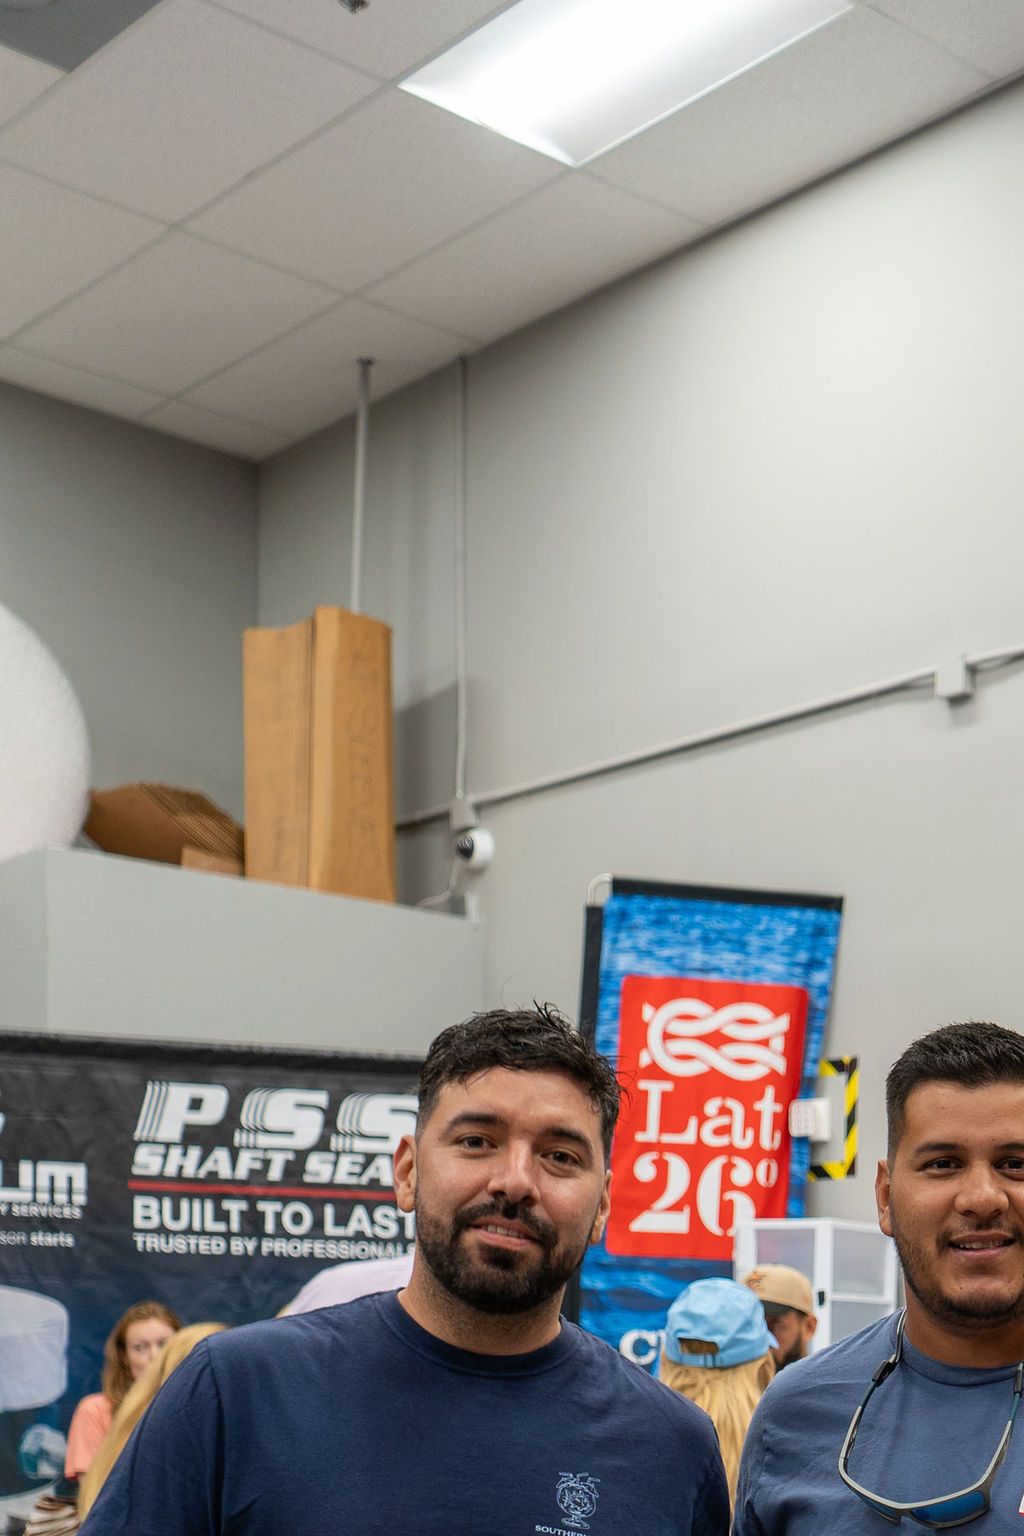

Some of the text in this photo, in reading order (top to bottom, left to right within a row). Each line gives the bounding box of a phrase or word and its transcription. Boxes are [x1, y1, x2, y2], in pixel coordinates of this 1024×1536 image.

[132, 1080, 418, 1152] PSS
[634, 1079, 784, 1151] Lat
[131, 1142, 394, 1187] SHAFT SEA
[11, 1203, 83, 1219] SERVICES
[132, 1194, 416, 1240] BUILT TO LAST
[30, 1230, 75, 1248] starts
[132, 1232, 228, 1256] TRUSTED
[230, 1236, 258, 1257] BY
